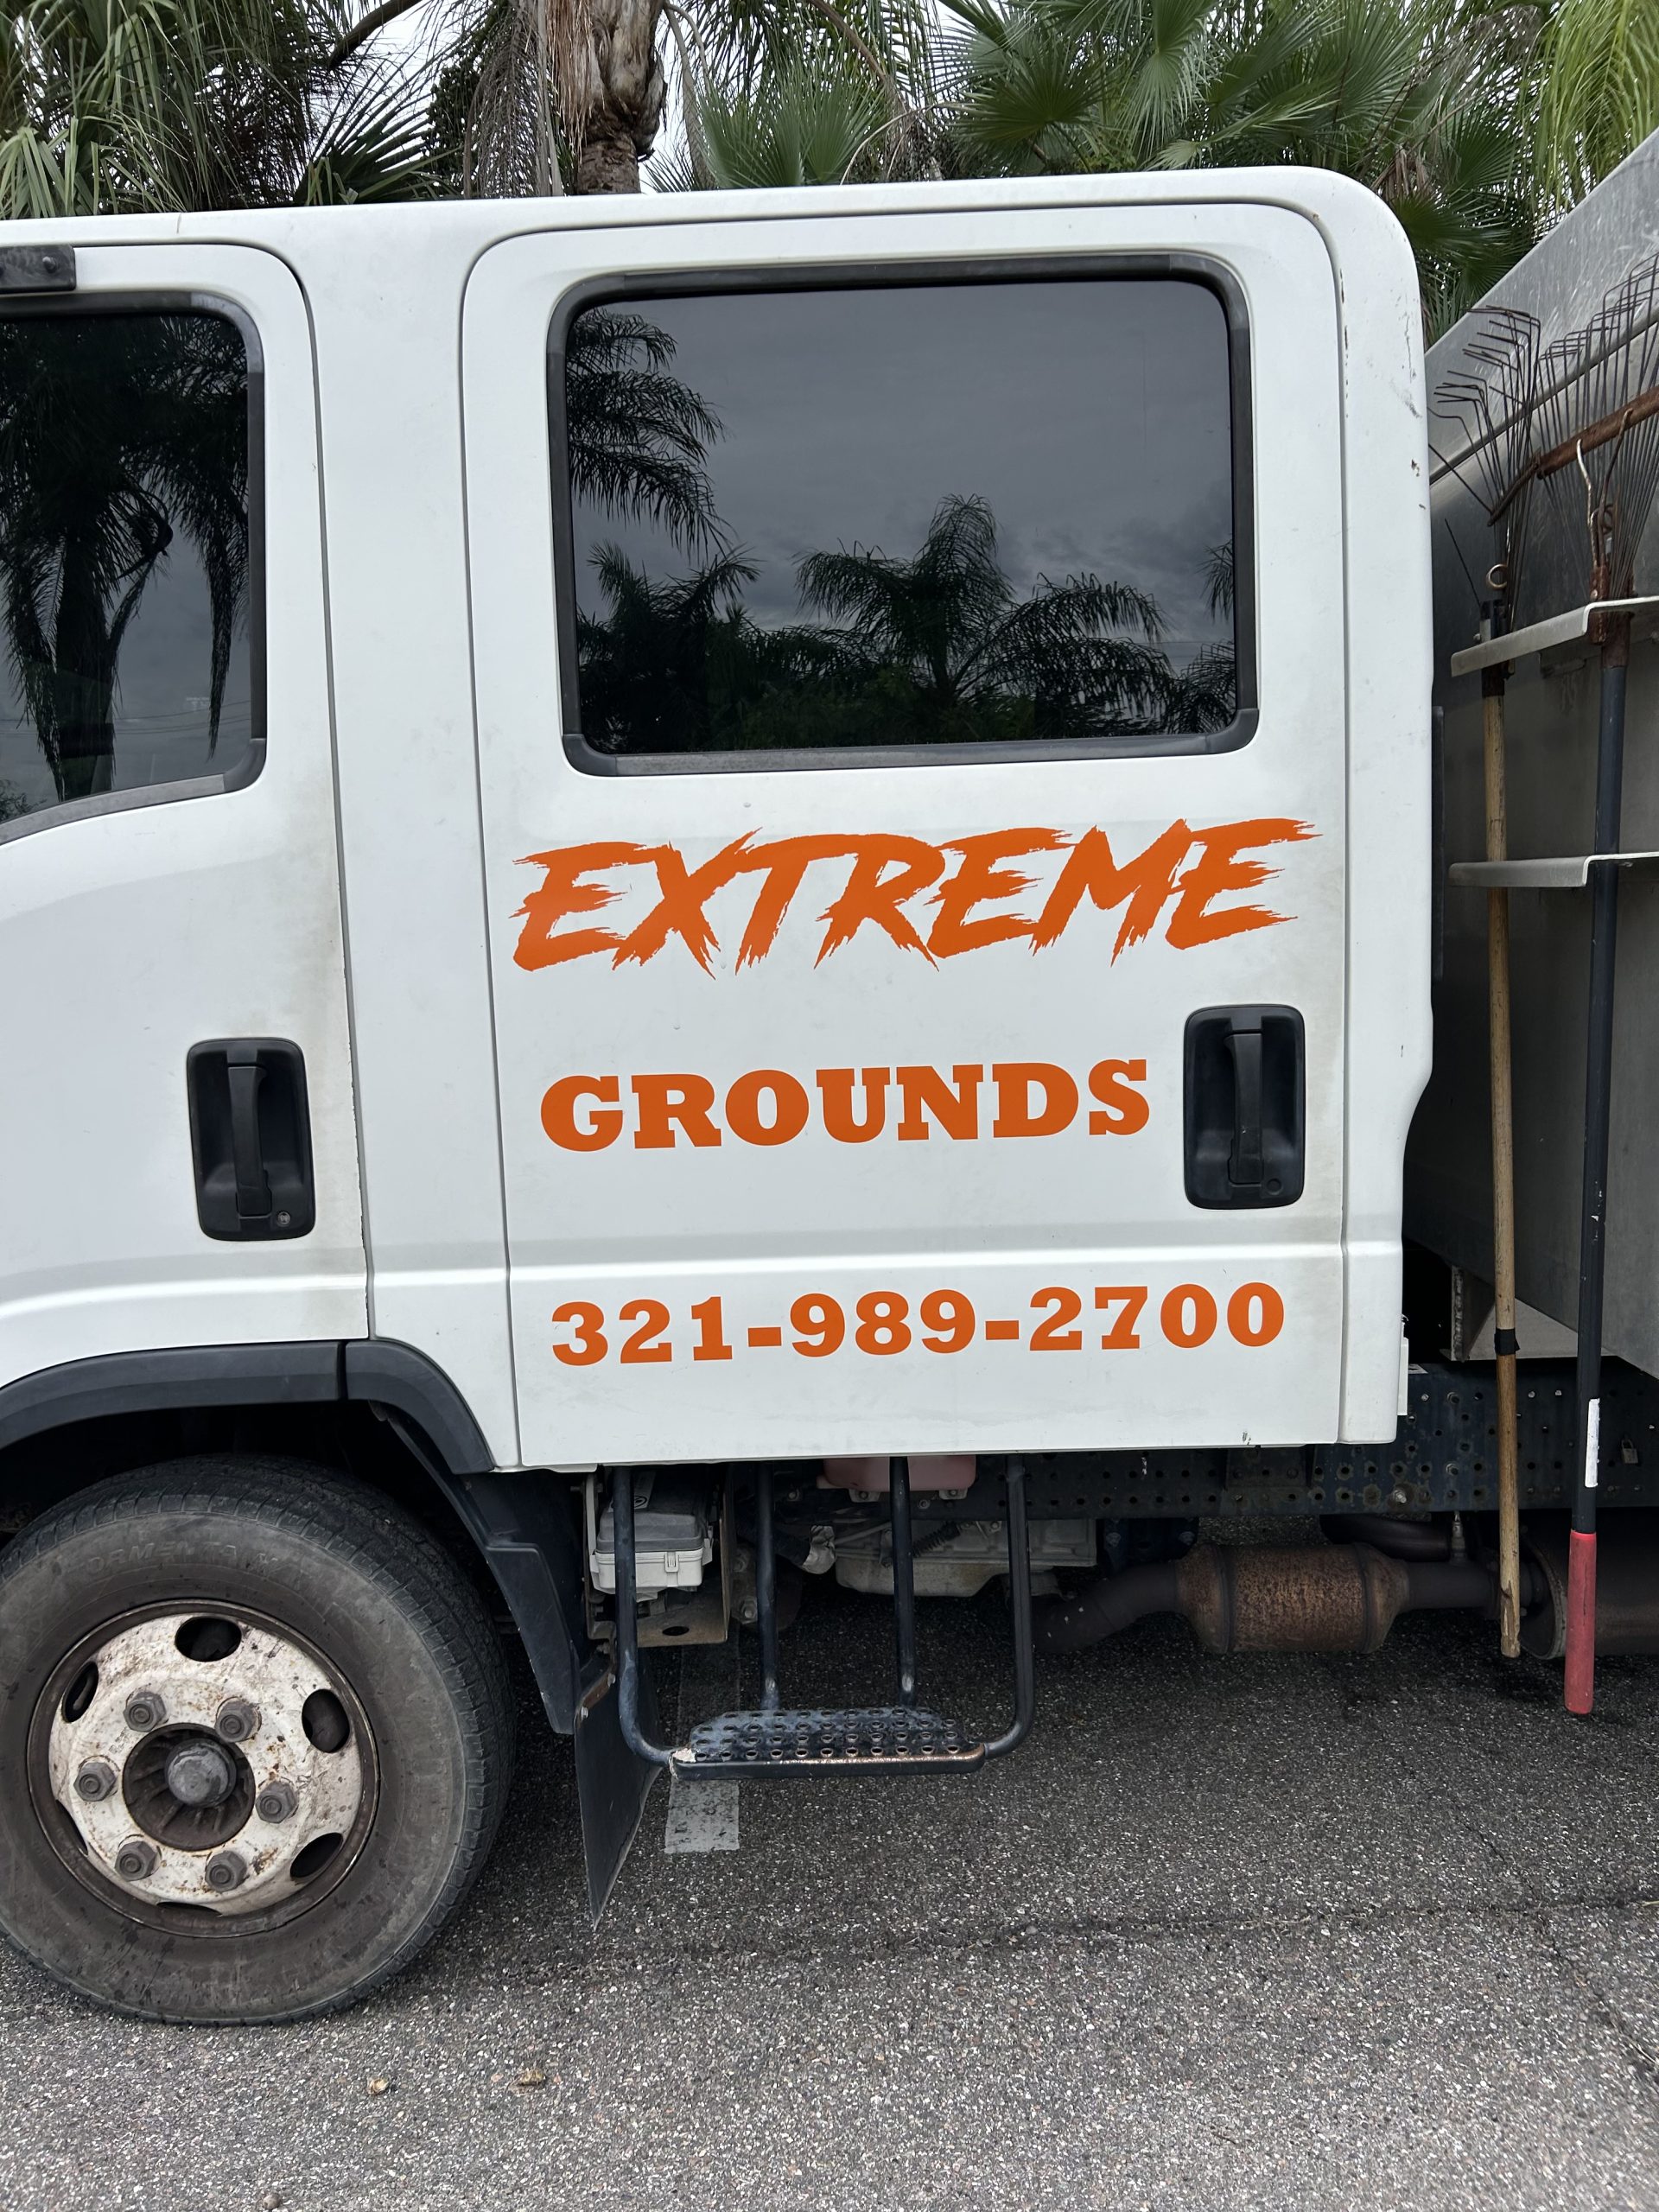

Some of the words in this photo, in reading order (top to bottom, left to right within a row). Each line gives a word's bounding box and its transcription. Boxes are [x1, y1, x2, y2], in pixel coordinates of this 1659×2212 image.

[508, 817, 1322, 980] EXTREME
[541, 1058, 1150, 1151] GROUNDS
[551, 1282, 1285, 1365] 321-989-2700
